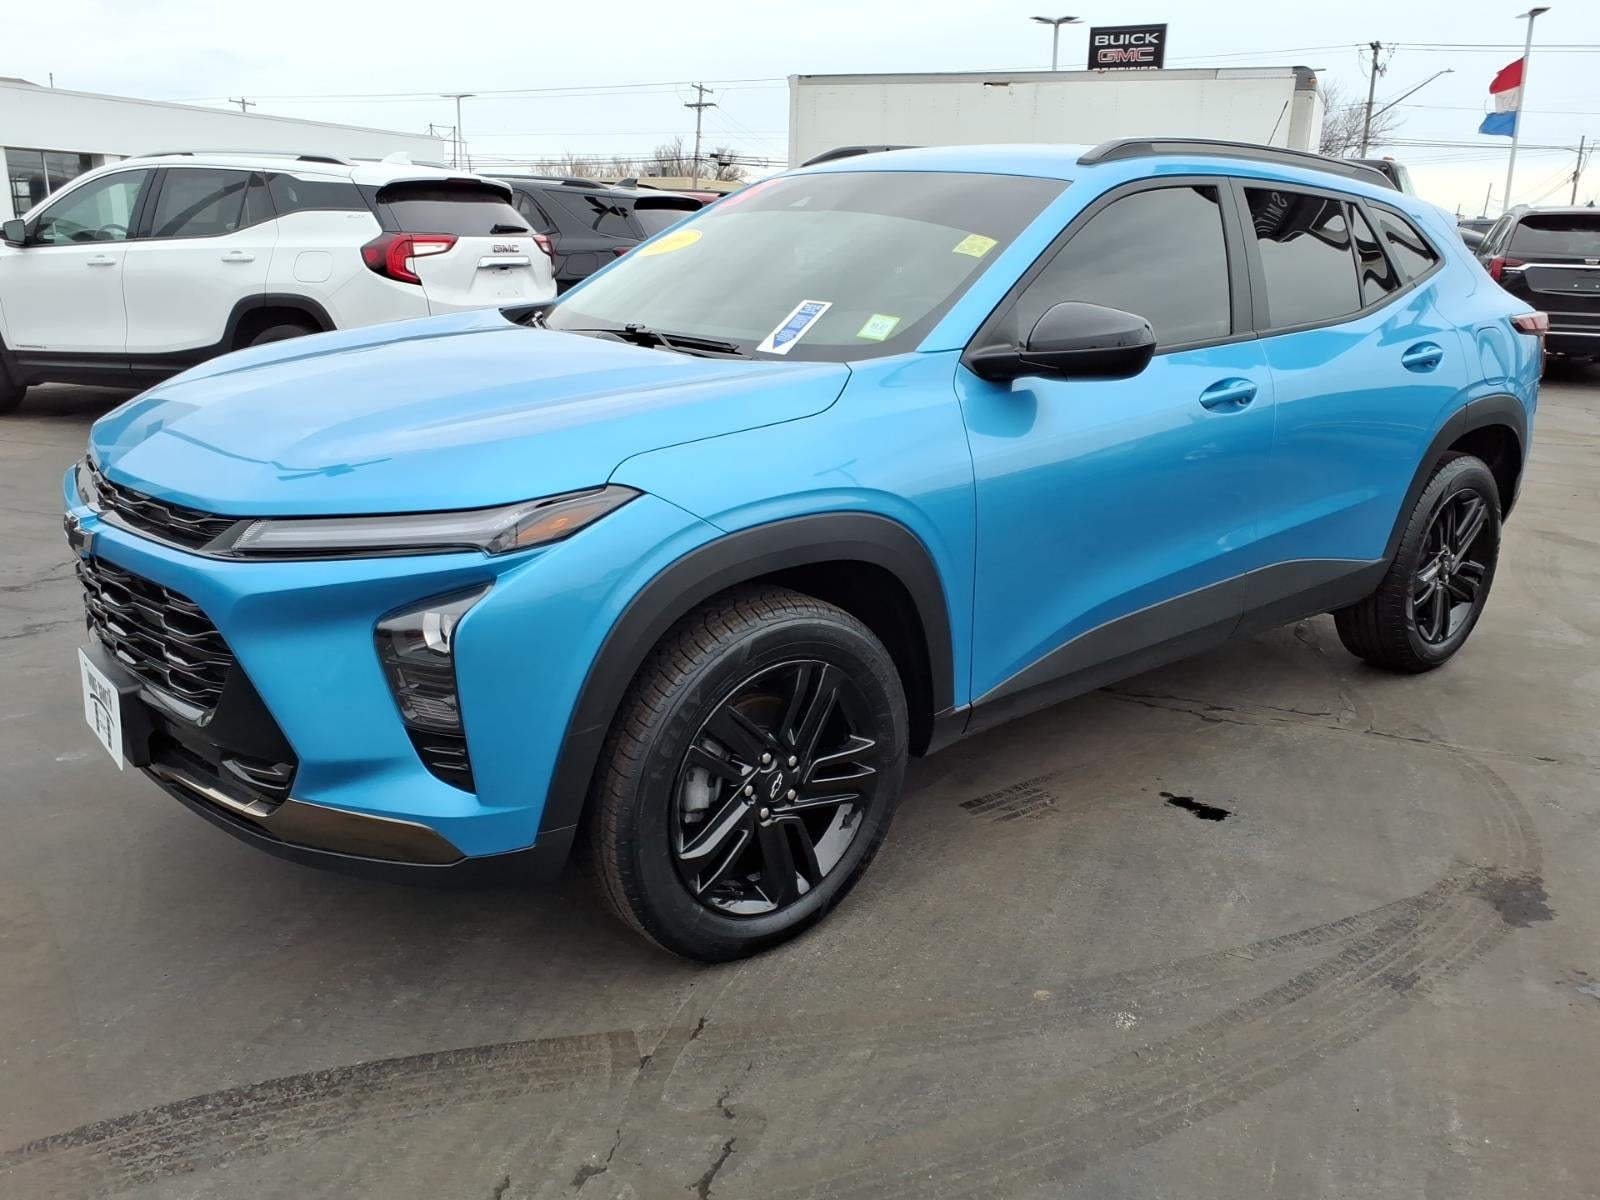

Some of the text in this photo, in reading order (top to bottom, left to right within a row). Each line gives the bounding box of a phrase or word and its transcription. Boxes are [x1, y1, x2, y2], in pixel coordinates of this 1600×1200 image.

[1094, 33, 1160, 46] BUICK
[1097, 47, 1155, 63] GMC
[493, 244, 520, 253] GMC
